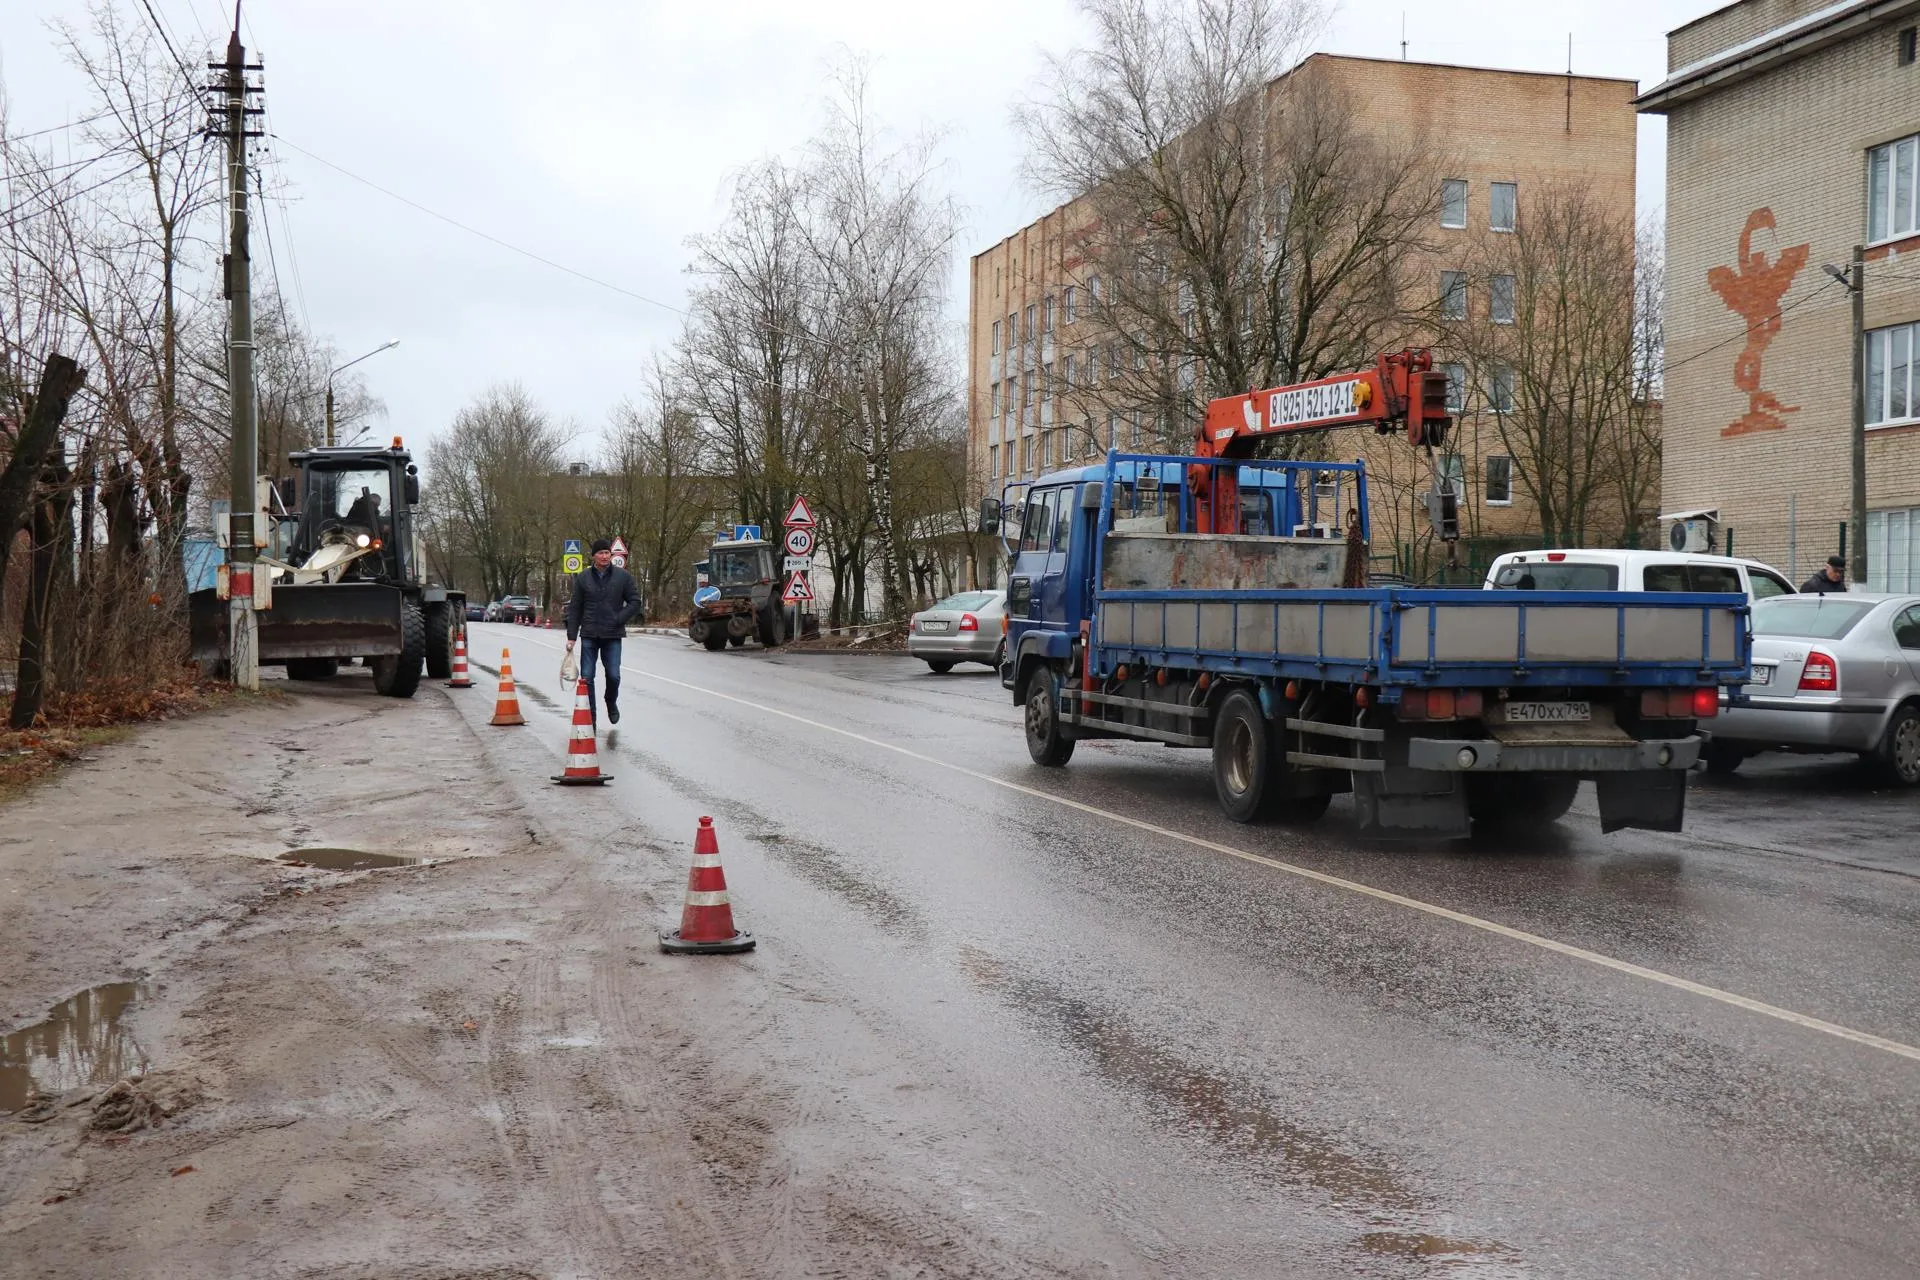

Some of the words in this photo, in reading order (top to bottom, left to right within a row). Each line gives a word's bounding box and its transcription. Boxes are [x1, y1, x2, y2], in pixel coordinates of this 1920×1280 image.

[1271, 395, 1278, 424] 8
[1279, 391, 1305, 424] (925)
[791, 536, 807, 547] 40
